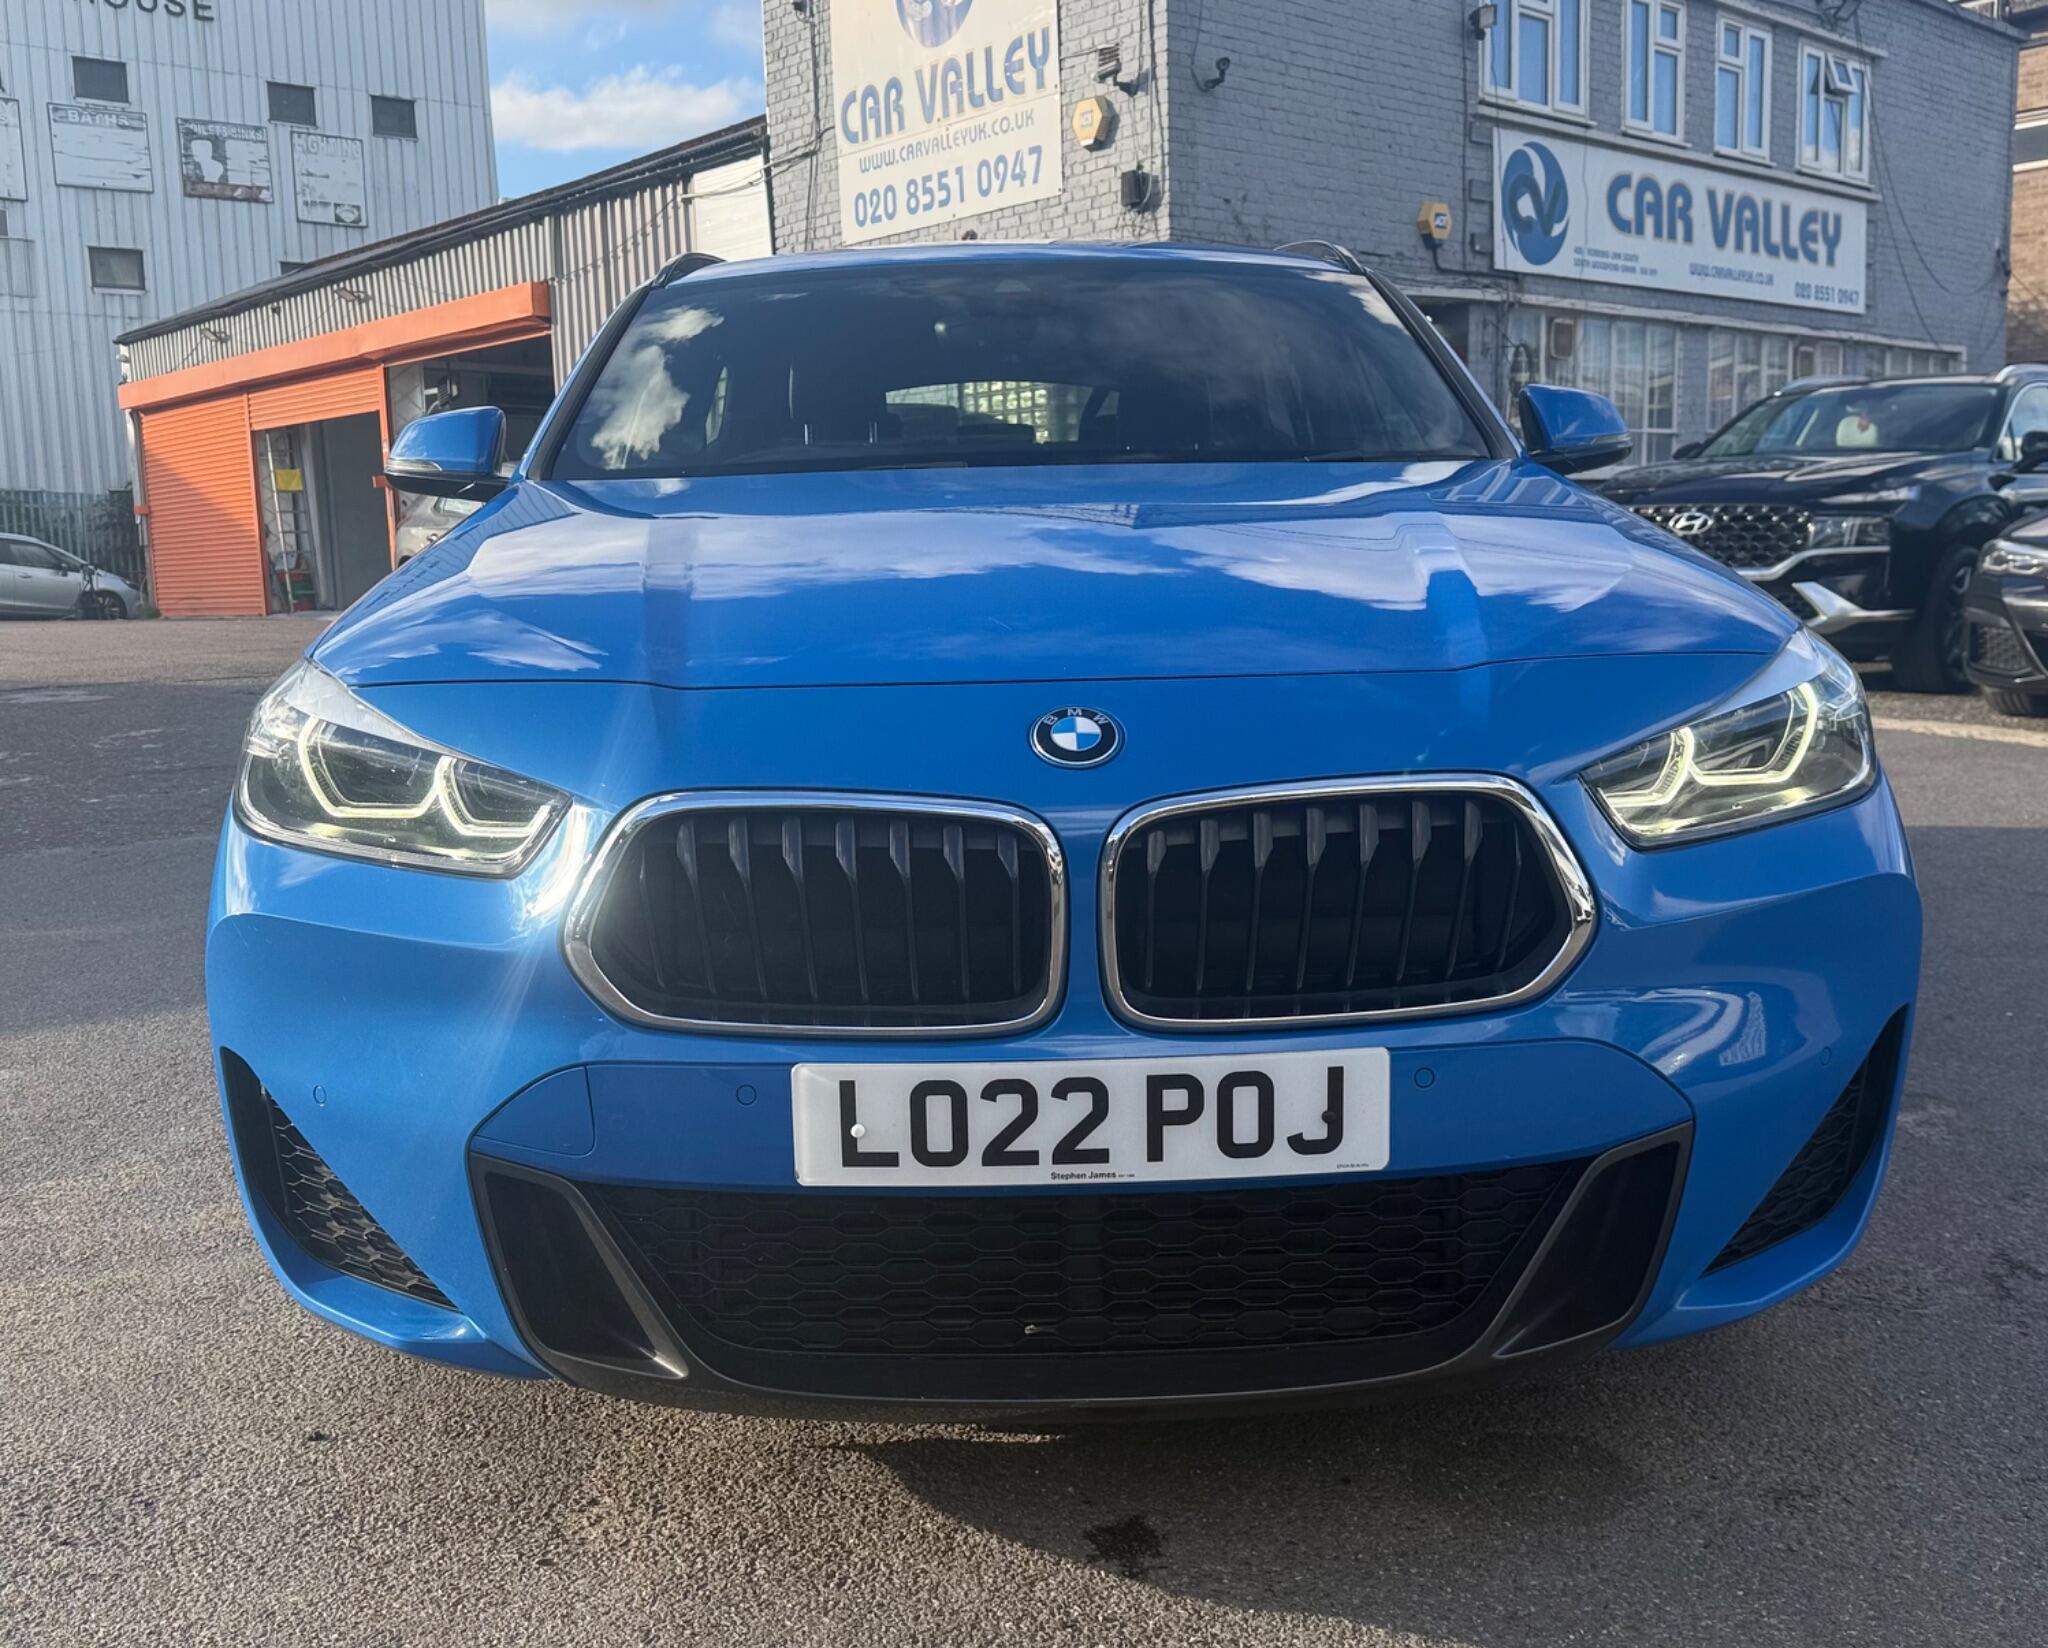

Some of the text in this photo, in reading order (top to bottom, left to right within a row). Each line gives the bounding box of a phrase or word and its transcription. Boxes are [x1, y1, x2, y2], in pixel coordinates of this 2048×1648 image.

[841, 26, 1050, 144] CAR VALLEY
[859, 108, 1034, 173] WWW.CARVALLEYUK.CO.UK
[855, 145, 1042, 227] 020 8551 0947
[1606, 172, 1842, 267] CAR VALLEY
[1043, 707, 1109, 726] BMW
[839, 1066, 1344, 1167] LO22 POJ
[1051, 1171, 1087, 1181] Stephen
[1088, 1171, 1117, 1179] James
